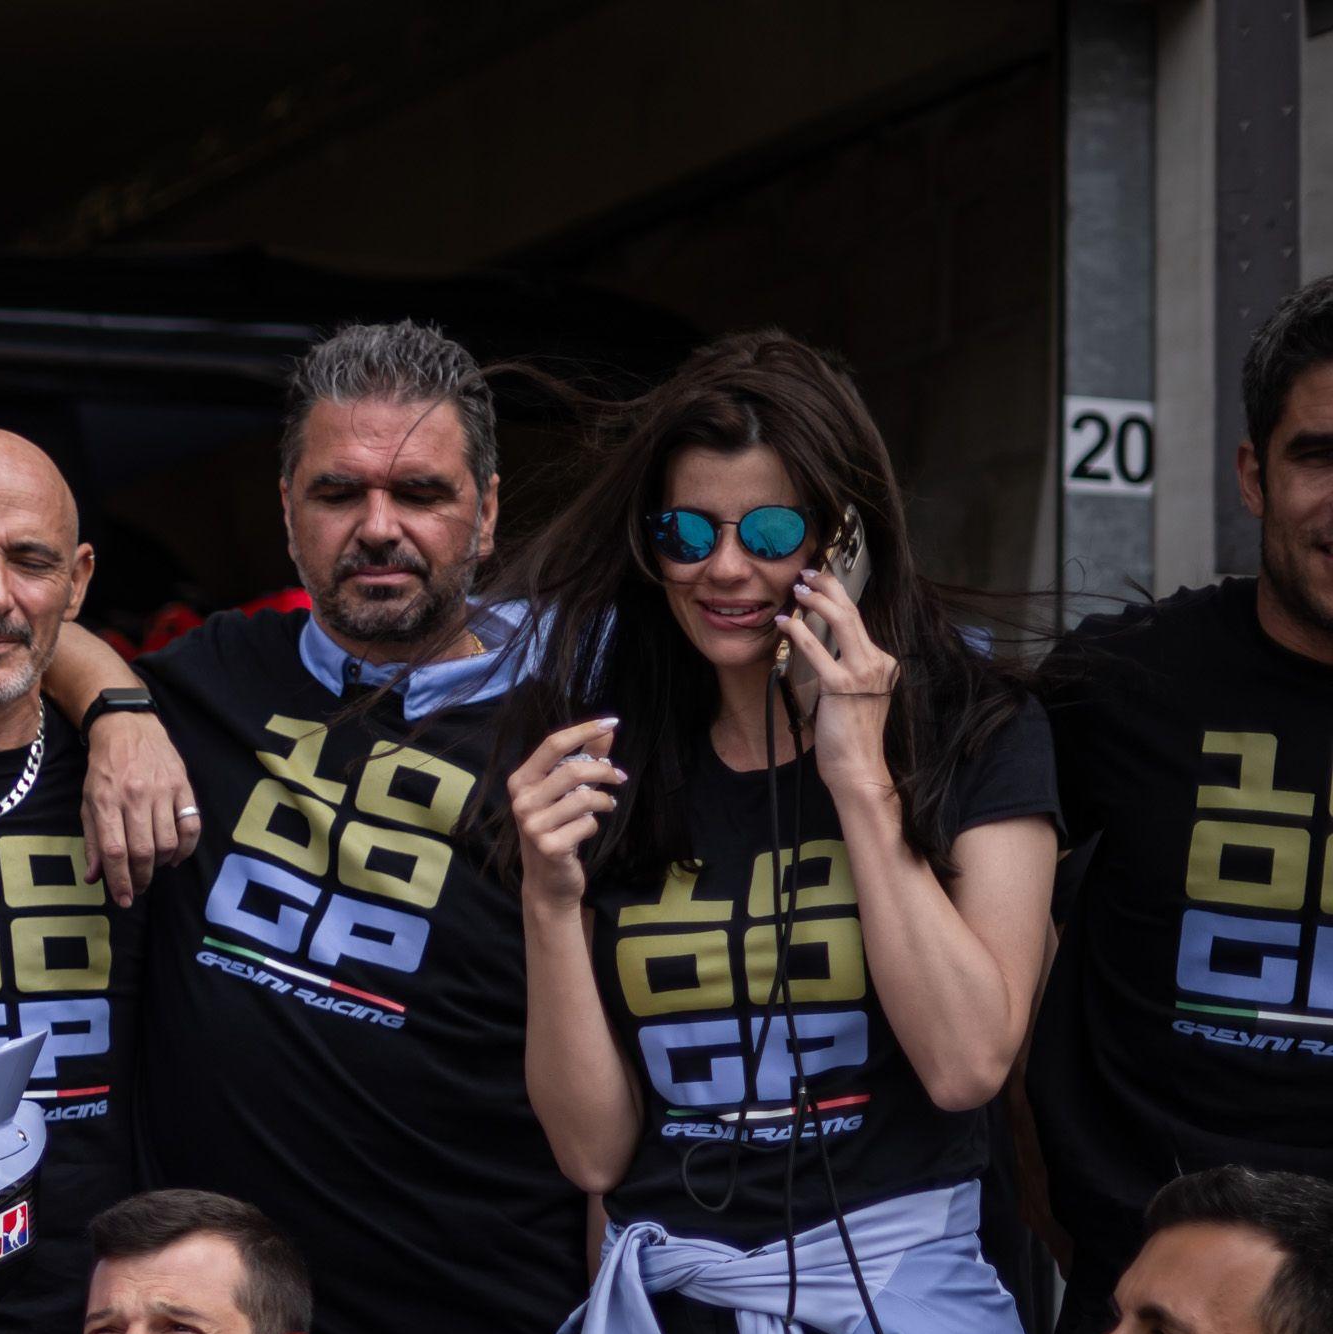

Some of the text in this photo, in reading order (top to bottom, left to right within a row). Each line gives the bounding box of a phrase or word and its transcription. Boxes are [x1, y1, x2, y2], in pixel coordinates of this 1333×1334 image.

[1069, 409, 1155, 486] 20
[1196, 731, 1333, 818] 1
[1185, 819, 1333, 911] 0
[204, 852, 431, 974] GP
[196, 950, 406, 1029] GRESINI RACING
[1176, 908, 1333, 1009] G
[638, 1010, 868, 1106] GP
[1172, 1019, 1295, 1051] GRESINI
[41, 1100, 108, 1121] ACING
